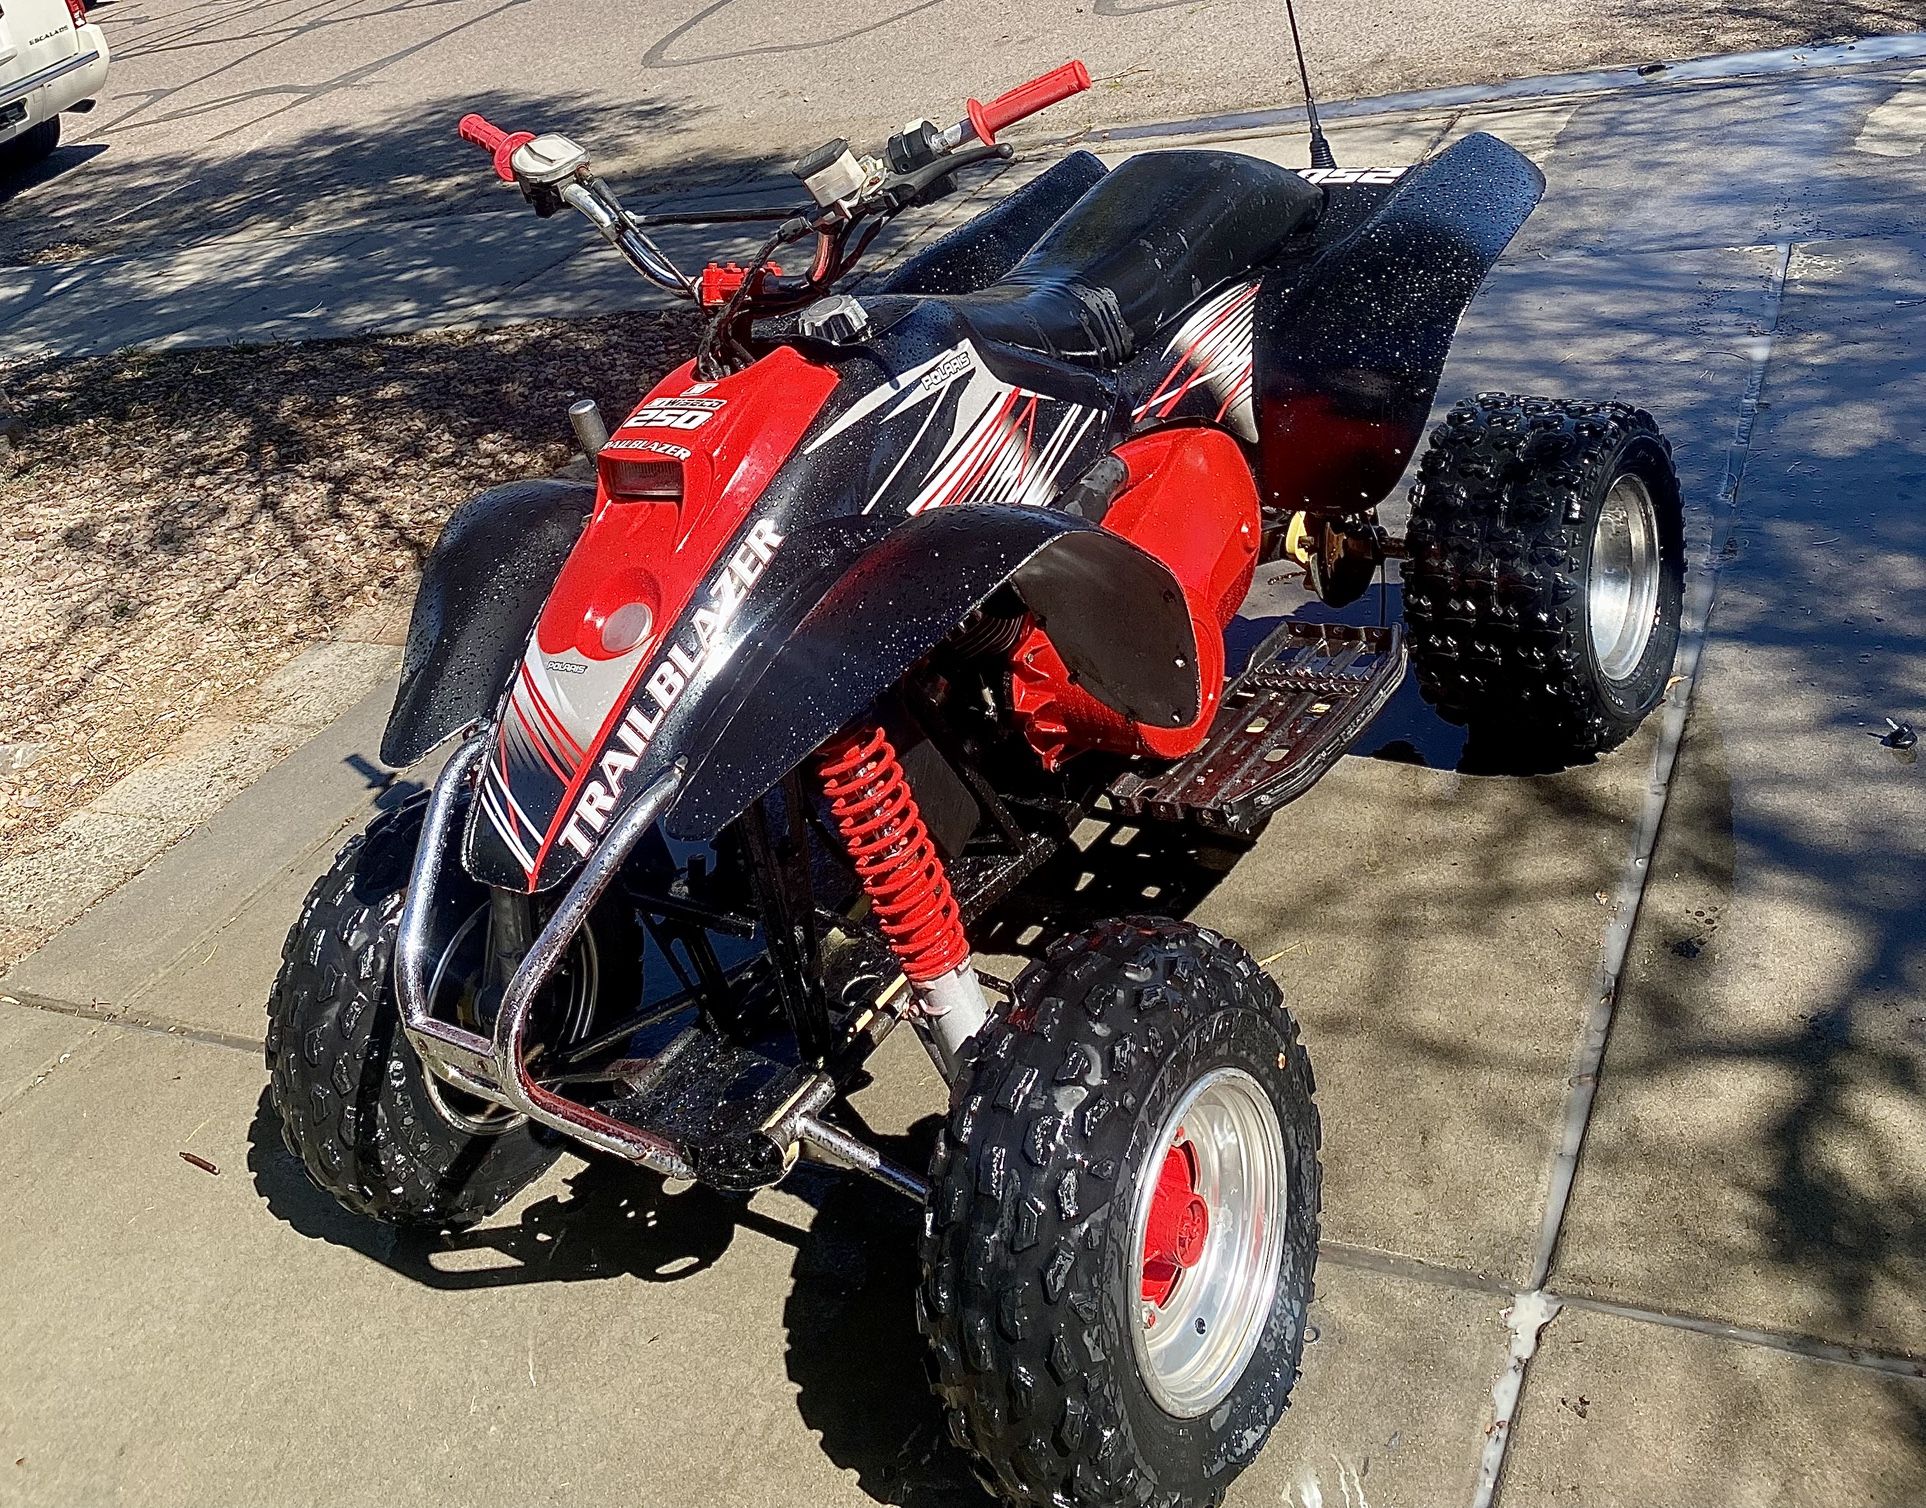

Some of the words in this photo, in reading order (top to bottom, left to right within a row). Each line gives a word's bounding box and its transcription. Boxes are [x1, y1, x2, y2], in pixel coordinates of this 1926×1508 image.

[29, 24, 69, 46] ESCALADE
[921, 351, 971, 391] POLARIS
[622, 408, 715, 430] 250
[600, 440, 692, 461] RAILBLAZER
[546, 661, 588, 675] POLARIS
[558, 518, 787, 858] TRAILBLAZER
